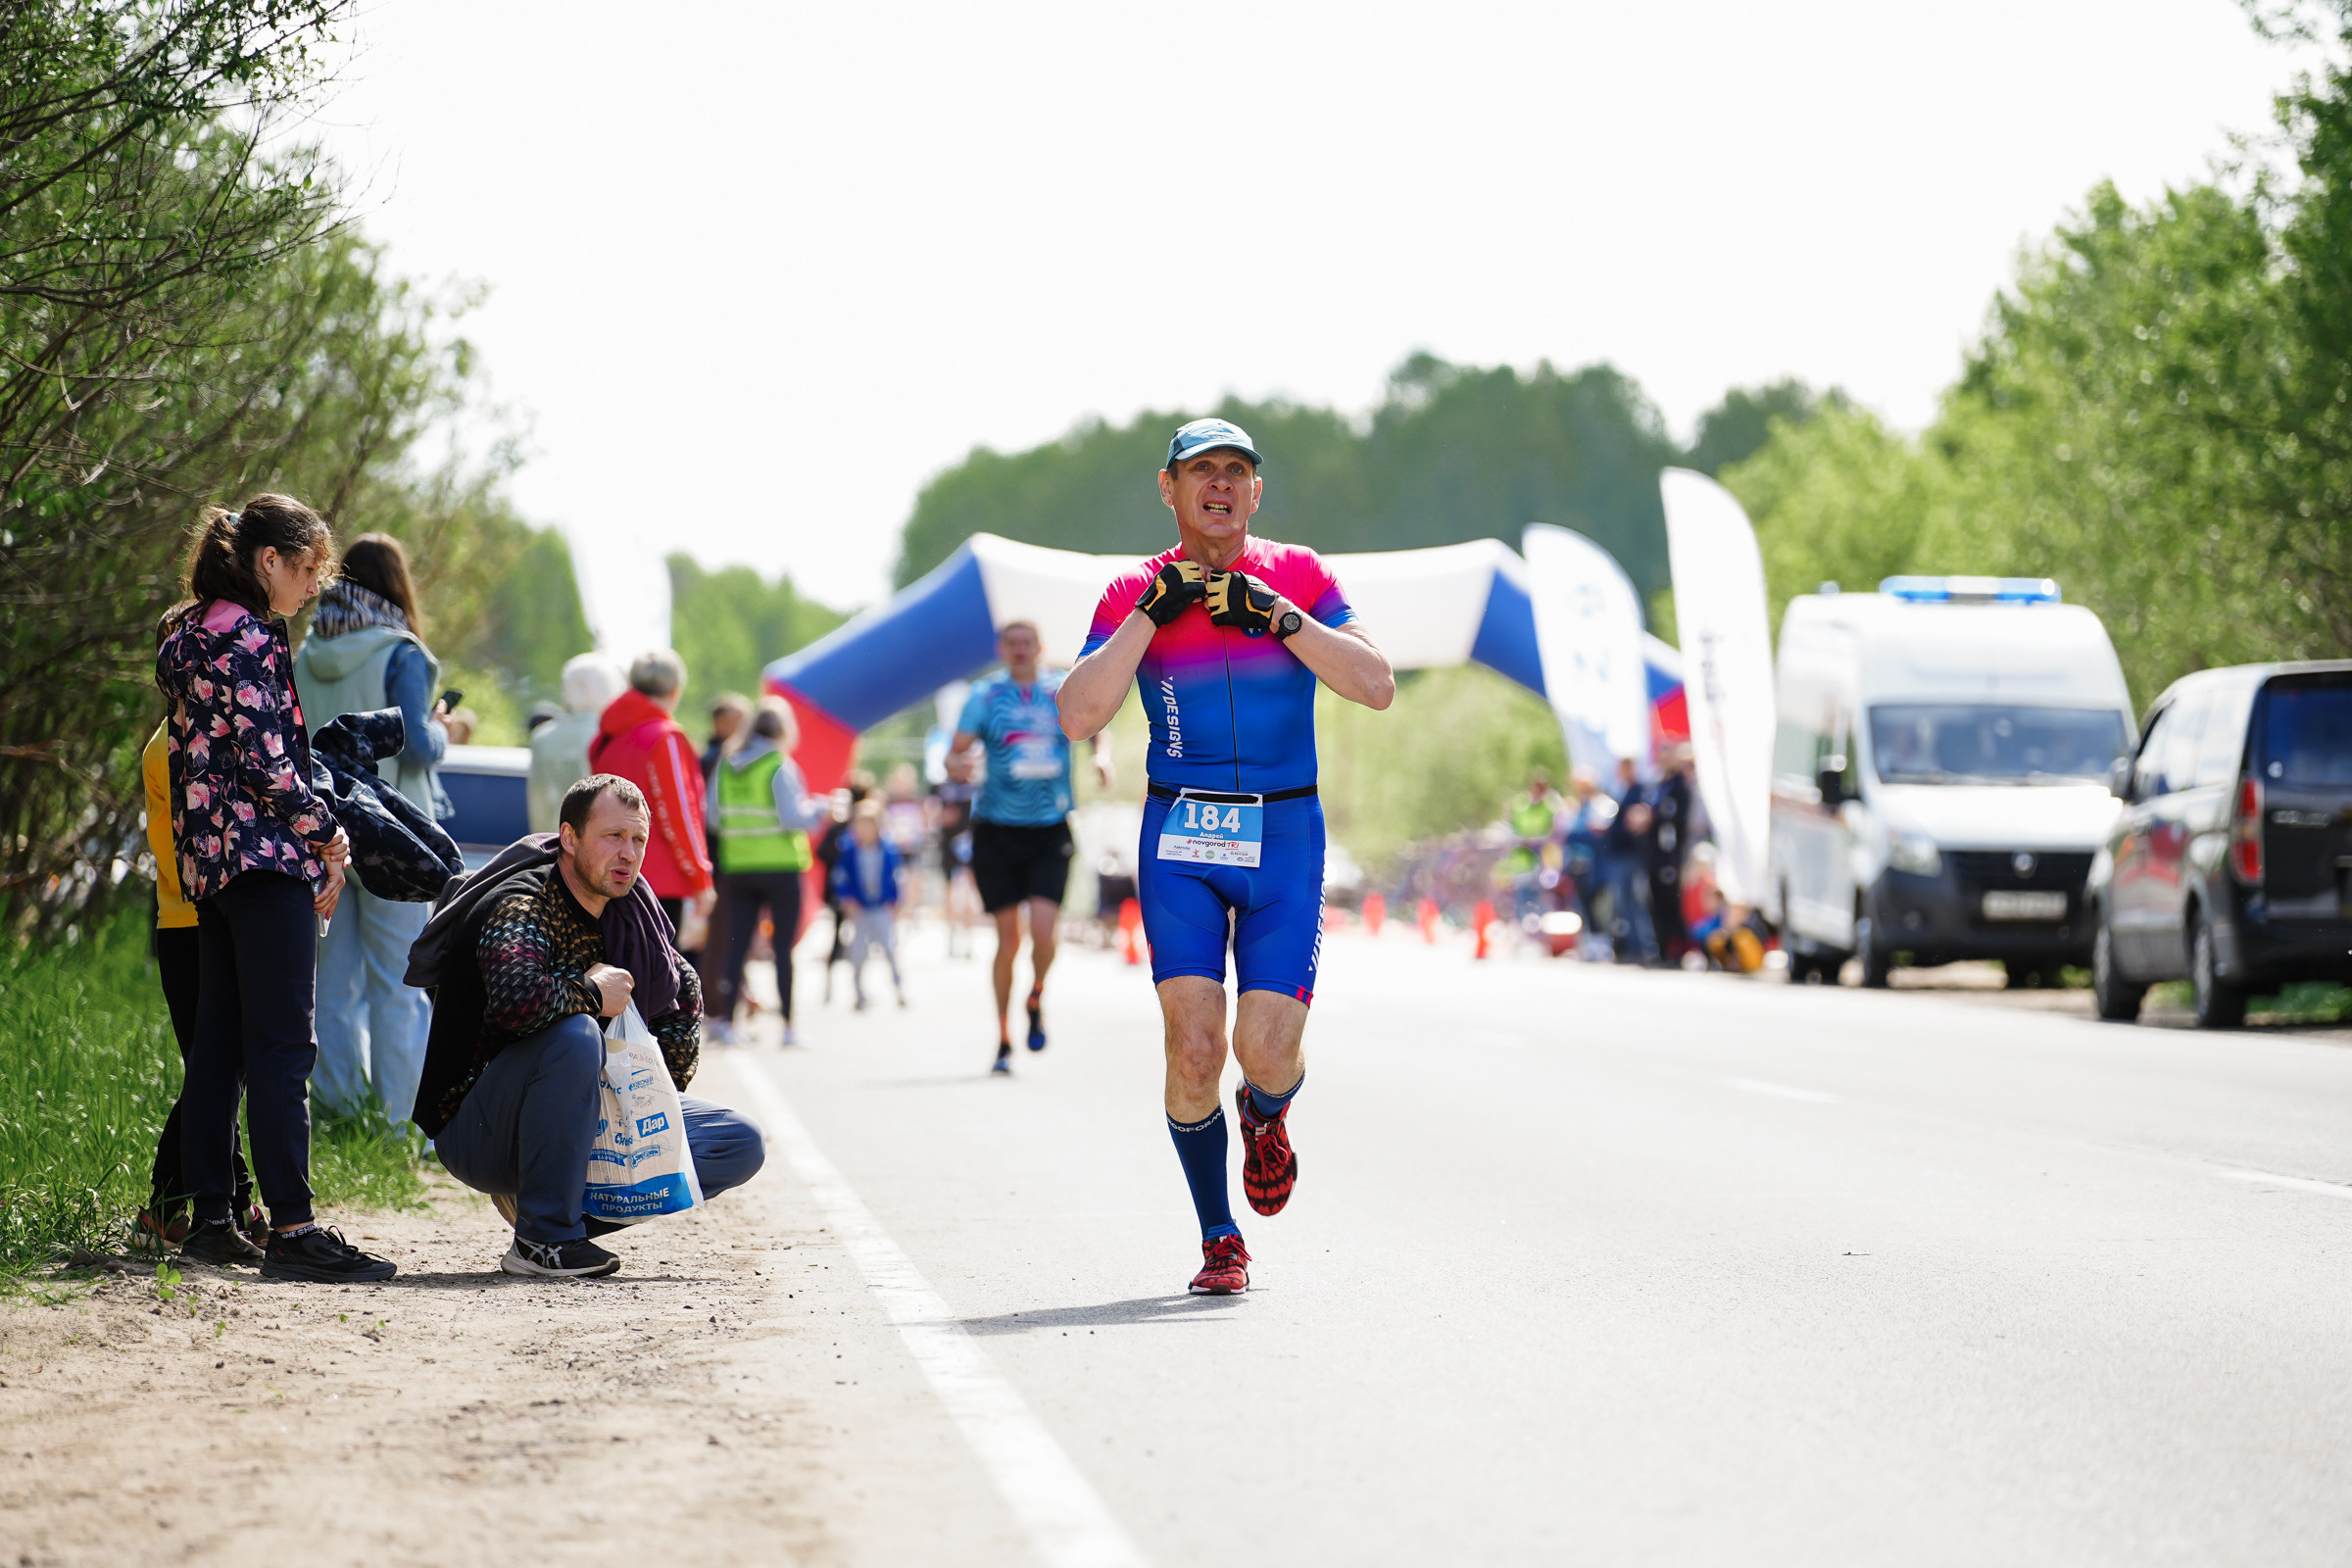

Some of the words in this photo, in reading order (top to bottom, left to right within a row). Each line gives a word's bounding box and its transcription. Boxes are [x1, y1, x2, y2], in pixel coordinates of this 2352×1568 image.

[1184, 803, 1241, 833] 184
[642, 1116, 665, 1136] Дар
[590, 1187, 670, 1204] НАТУРАЛЬНЫЕ
[601, 1201, 662, 1213] ПРОДУКТЫ
